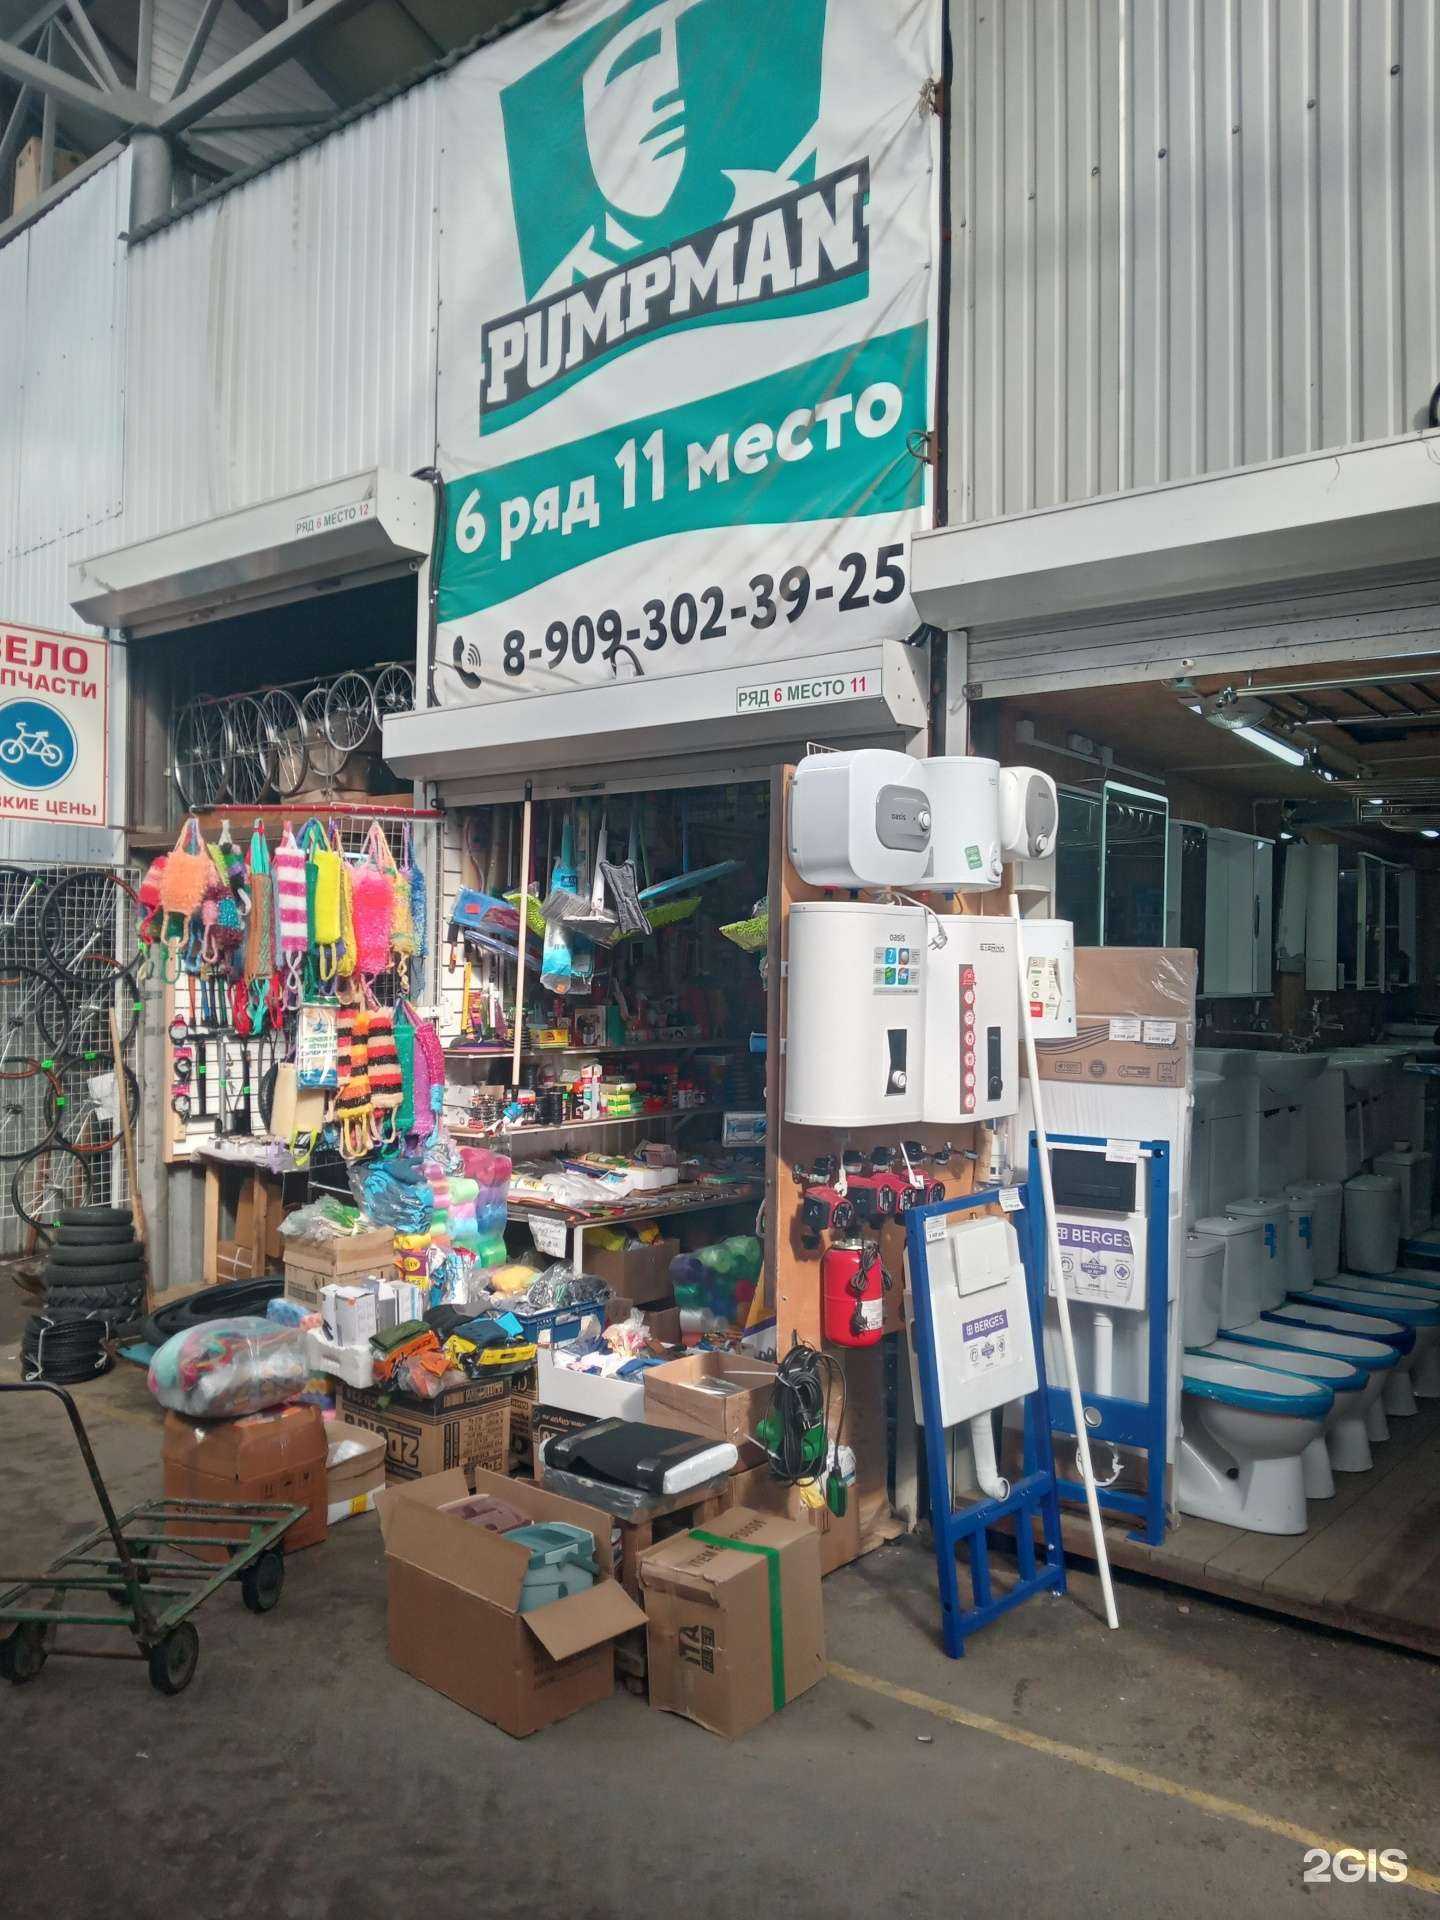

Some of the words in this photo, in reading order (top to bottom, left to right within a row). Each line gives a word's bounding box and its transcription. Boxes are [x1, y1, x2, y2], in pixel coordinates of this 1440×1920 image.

[485, 174, 861, 404] PUMPMAN
[455, 487, 486, 554] 6
[501, 473, 600, 562] ряд
[614, 428, 665, 508] 11
[687, 381, 903, 492] место
[296, 519, 315, 534] РЯД
[316, 517, 322, 529] 6
[323, 507, 357, 526] МЕСТО
[359, 503, 369, 517] 12
[503, 543, 906, 677] 8-909-302-39-25
[0, 634, 88, 675] ЕЛО
[738, 689, 769, 708] РЯД
[774, 687, 782, 703] 6
[787, 679, 845, 701] МЕСТО
[850, 676, 866, 693] 11
[0, 794, 39, 811] КИЕ
[46, 799, 97, 817] ЦЕНЫ
[890, 934, 905, 942] oasis
[1072, 1228, 1131, 1247] BERGES
[974, 1314, 1004, 1334] BERGES
